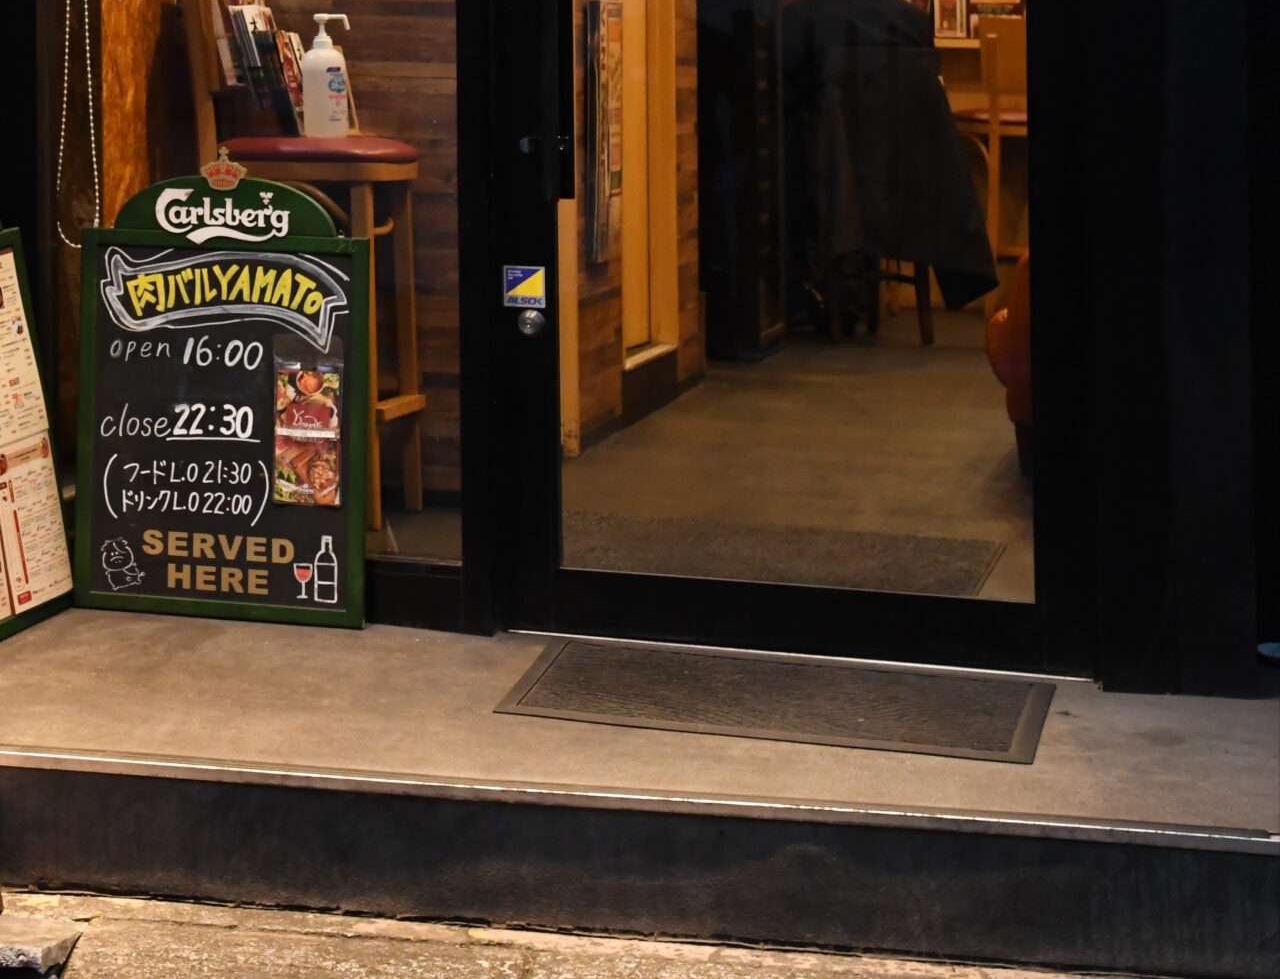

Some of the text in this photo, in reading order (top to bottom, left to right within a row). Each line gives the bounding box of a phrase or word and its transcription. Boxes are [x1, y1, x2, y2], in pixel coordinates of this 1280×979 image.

[155, 188, 290, 238] Carlsberg
[126, 264, 324, 317] 肉バルYAMATO
[507, 297, 542, 305] ALSOK
[110, 335, 263, 370] open 16:00
[100, 403, 253, 439] close 22:30
[142, 529, 295, 565] SERVED
[167, 563, 269, 595] HERE
